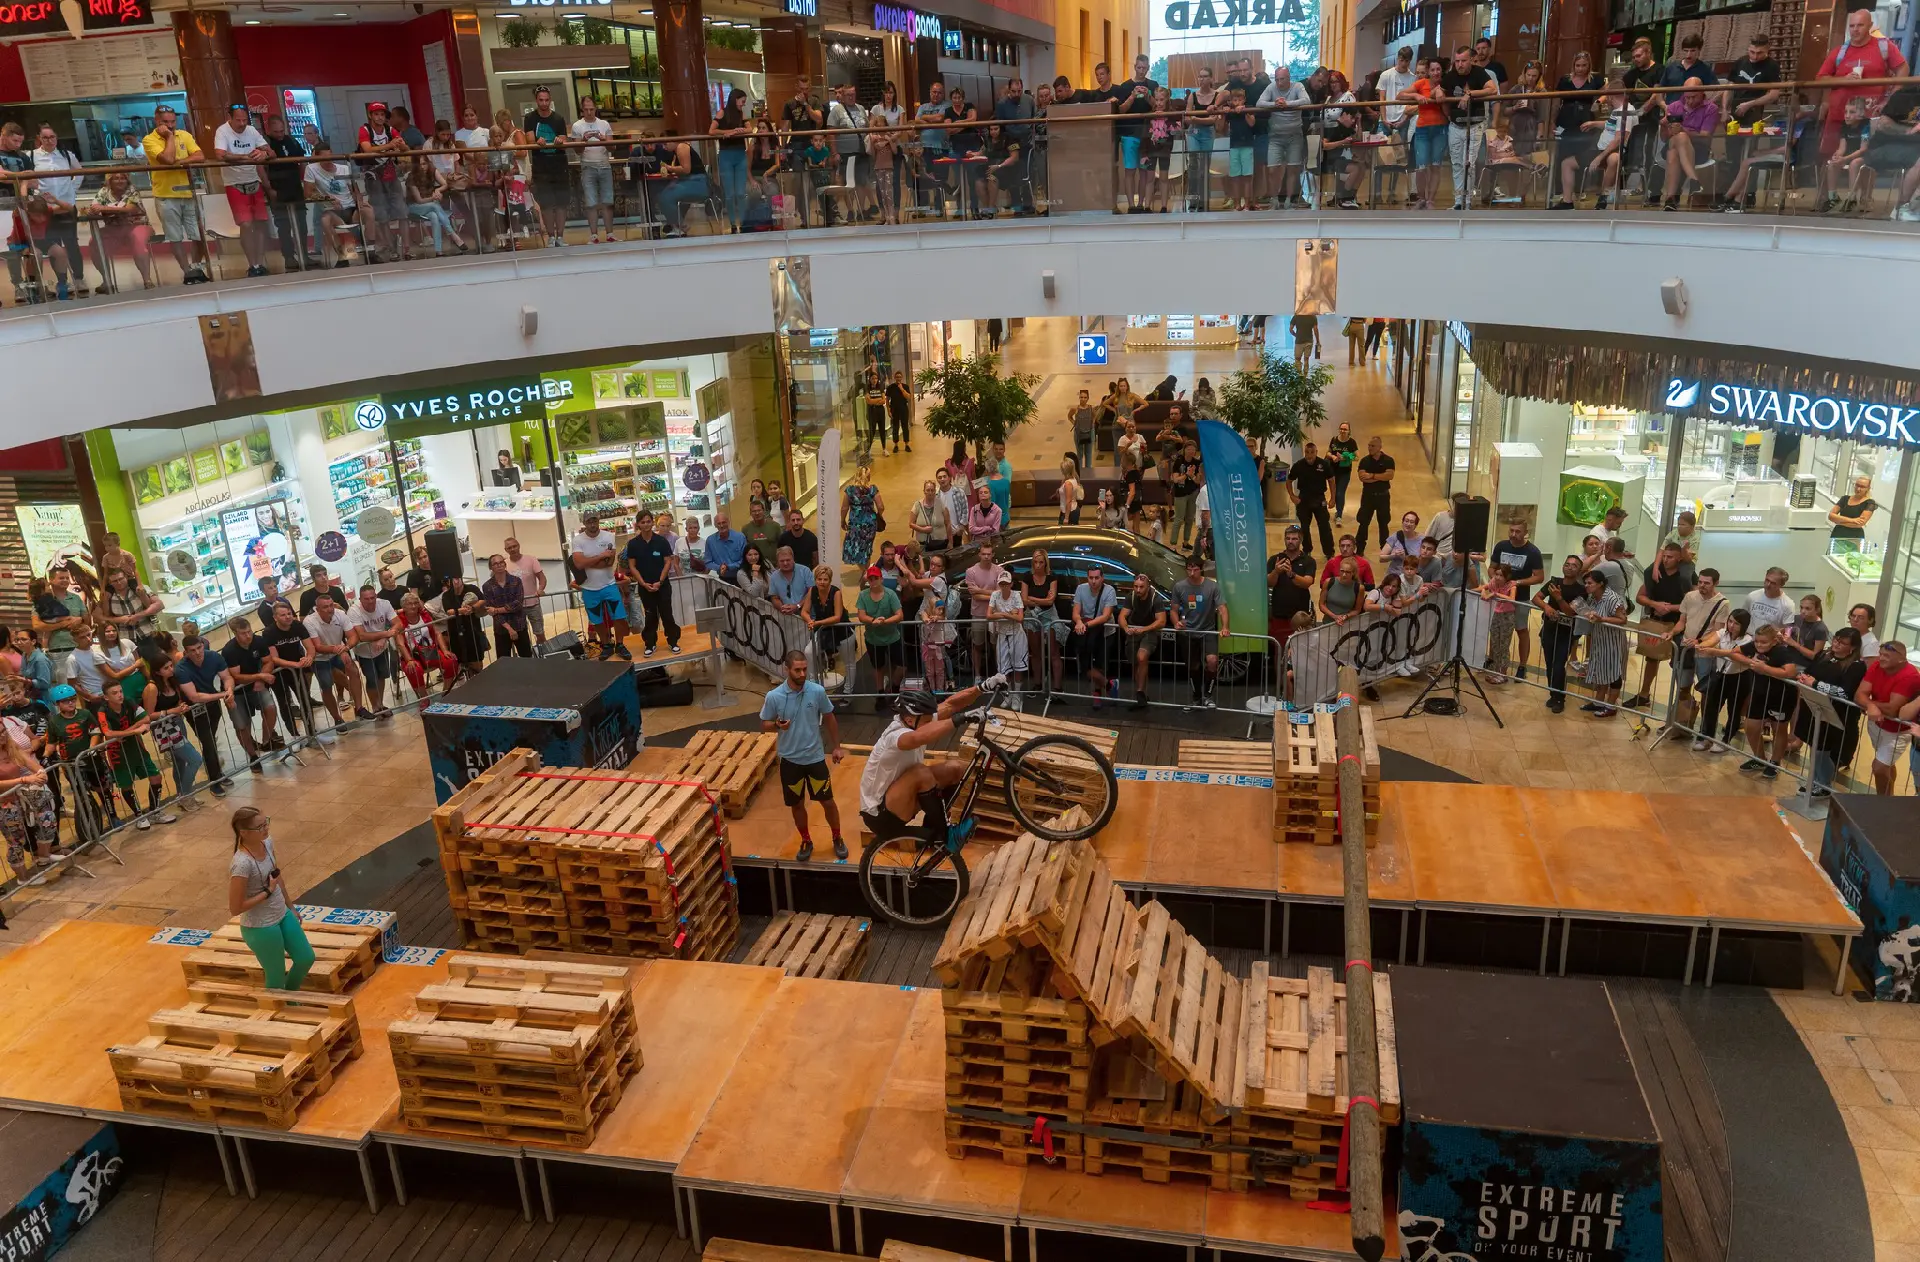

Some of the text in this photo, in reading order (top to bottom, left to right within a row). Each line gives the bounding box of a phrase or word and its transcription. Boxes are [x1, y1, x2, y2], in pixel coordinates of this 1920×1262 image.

[874, 4, 941, 39] purple panda
[1079, 337, 1105, 358] P 0
[391, 380, 574, 420] YVES ROCHER
[451, 405, 522, 423] FRANCE
[1709, 384, 1920, 443] SWAROVSK
[1728, 515, 1762, 525] SWAROVSKI
[321, 537, 340, 550] 2+1
[1480, 1182, 1624, 1217] EXTREME
[1477, 1205, 1622, 1251] SPORT
[1501, 1244, 1538, 1258] YOUR
[1546, 1246, 1593, 1262] EVENT
